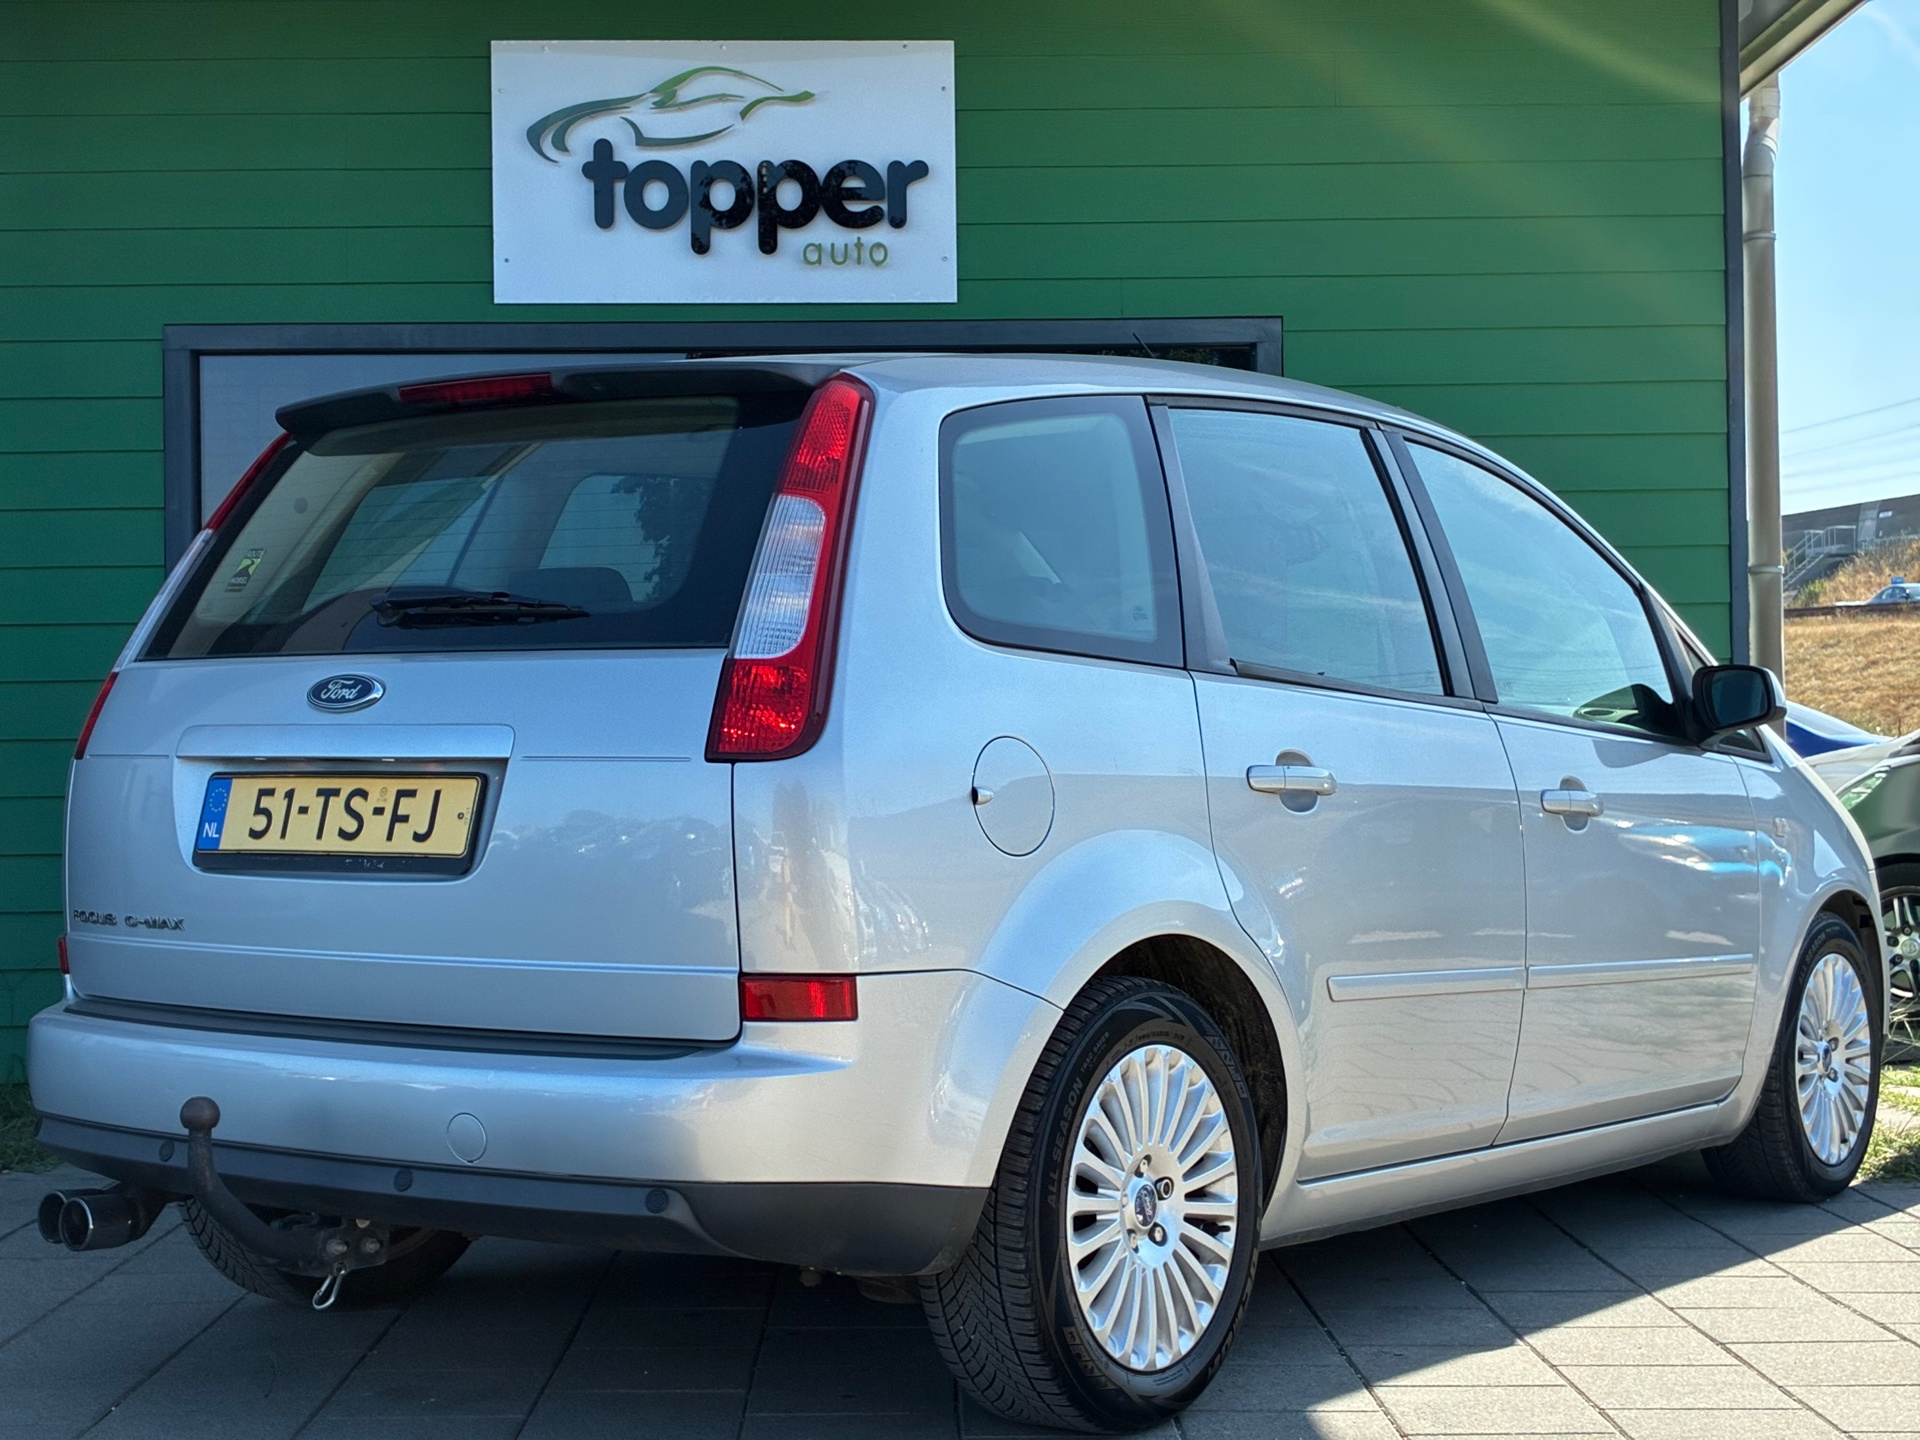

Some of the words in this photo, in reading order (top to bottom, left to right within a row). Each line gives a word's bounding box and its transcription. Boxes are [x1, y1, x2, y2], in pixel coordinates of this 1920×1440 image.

[582, 138, 929, 255] topper
[803, 236, 888, 266] auto
[320, 679, 362, 700] Ford
[202, 822, 220, 838] NL
[247, 787, 442, 843] 51-TS-FJ
[73, 910, 118, 926] FOCUS
[124, 915, 186, 931] C-MAX
[1053, 1076, 1084, 1165] SEASON
